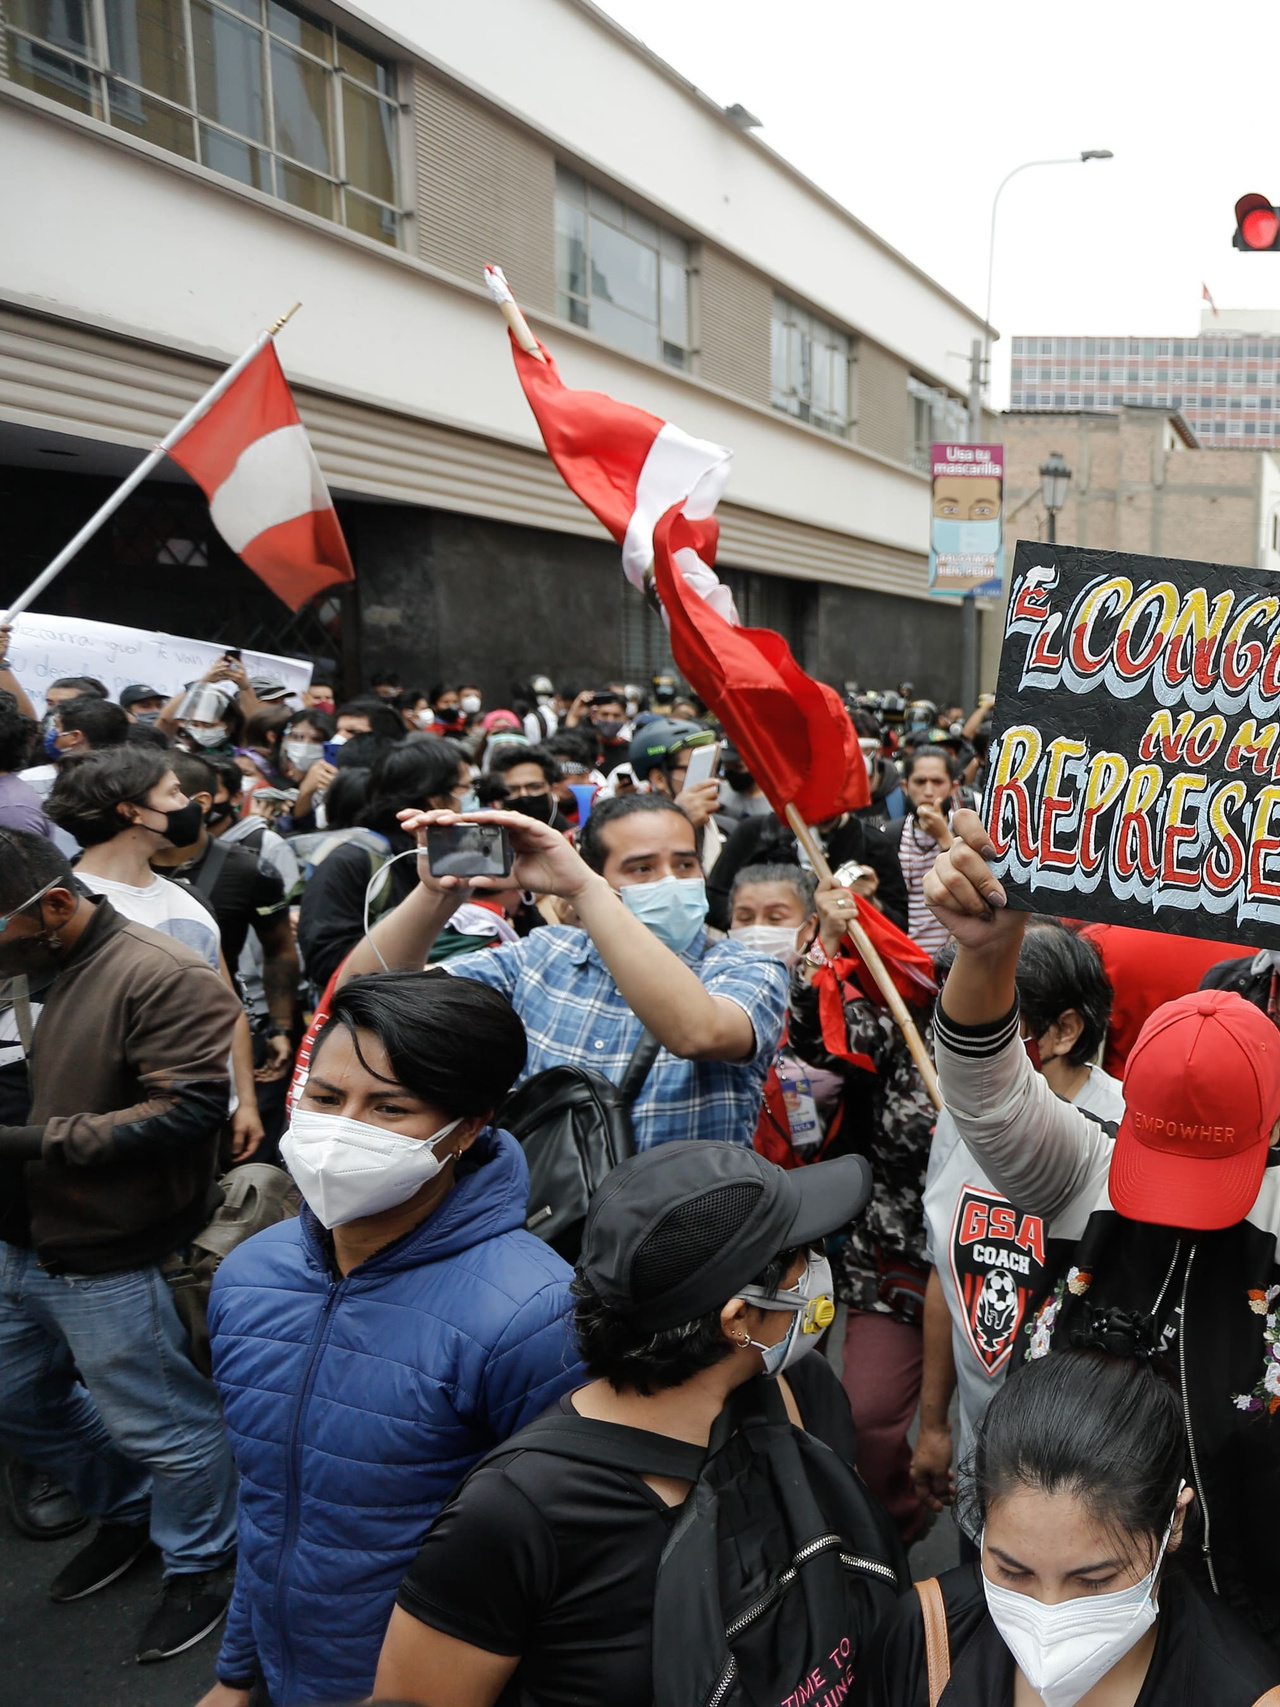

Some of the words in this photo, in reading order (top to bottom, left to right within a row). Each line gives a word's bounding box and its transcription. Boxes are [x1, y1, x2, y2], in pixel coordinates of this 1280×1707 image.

[934, 460, 1002, 476] mascarilla
[946, 446, 974, 462] Usa
[975, 449, 991, 463] tu
[1012, 565, 1064, 671] EL
[1138, 708, 1227, 767] NO
[1135, 1111, 1236, 1143] EMPOWHER
[959, 1200, 1046, 1267] GSA
[972, 1243, 1030, 1275] COACH
[781, 1666, 827, 1707] TIME
[829, 1637, 851, 1669] TO
